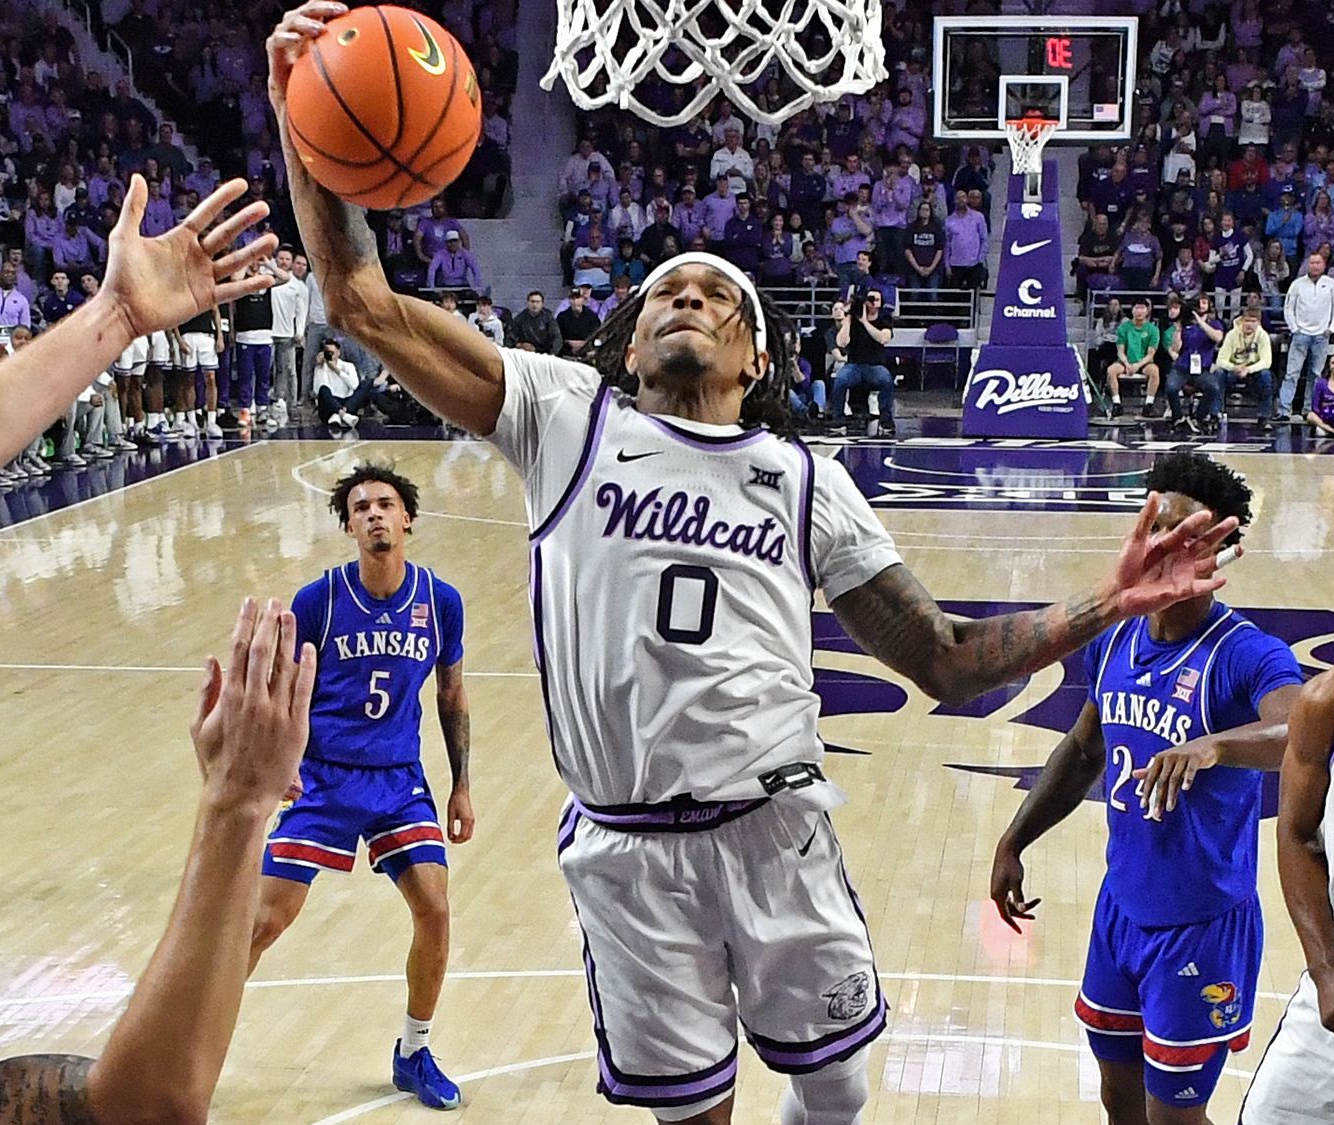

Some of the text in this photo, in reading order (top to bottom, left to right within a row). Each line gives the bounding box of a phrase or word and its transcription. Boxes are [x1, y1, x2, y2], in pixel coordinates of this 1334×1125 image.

[1003, 305, 1057, 318] Channel
[972, 370, 1079, 410] Dillons
[596, 482, 787, 566] Wildcats
[655, 563, 719, 645] 0
[334, 630, 430, 662] KANSAS
[364, 669, 391, 719] 5
[1100, 691, 1193, 746] KANSAS
